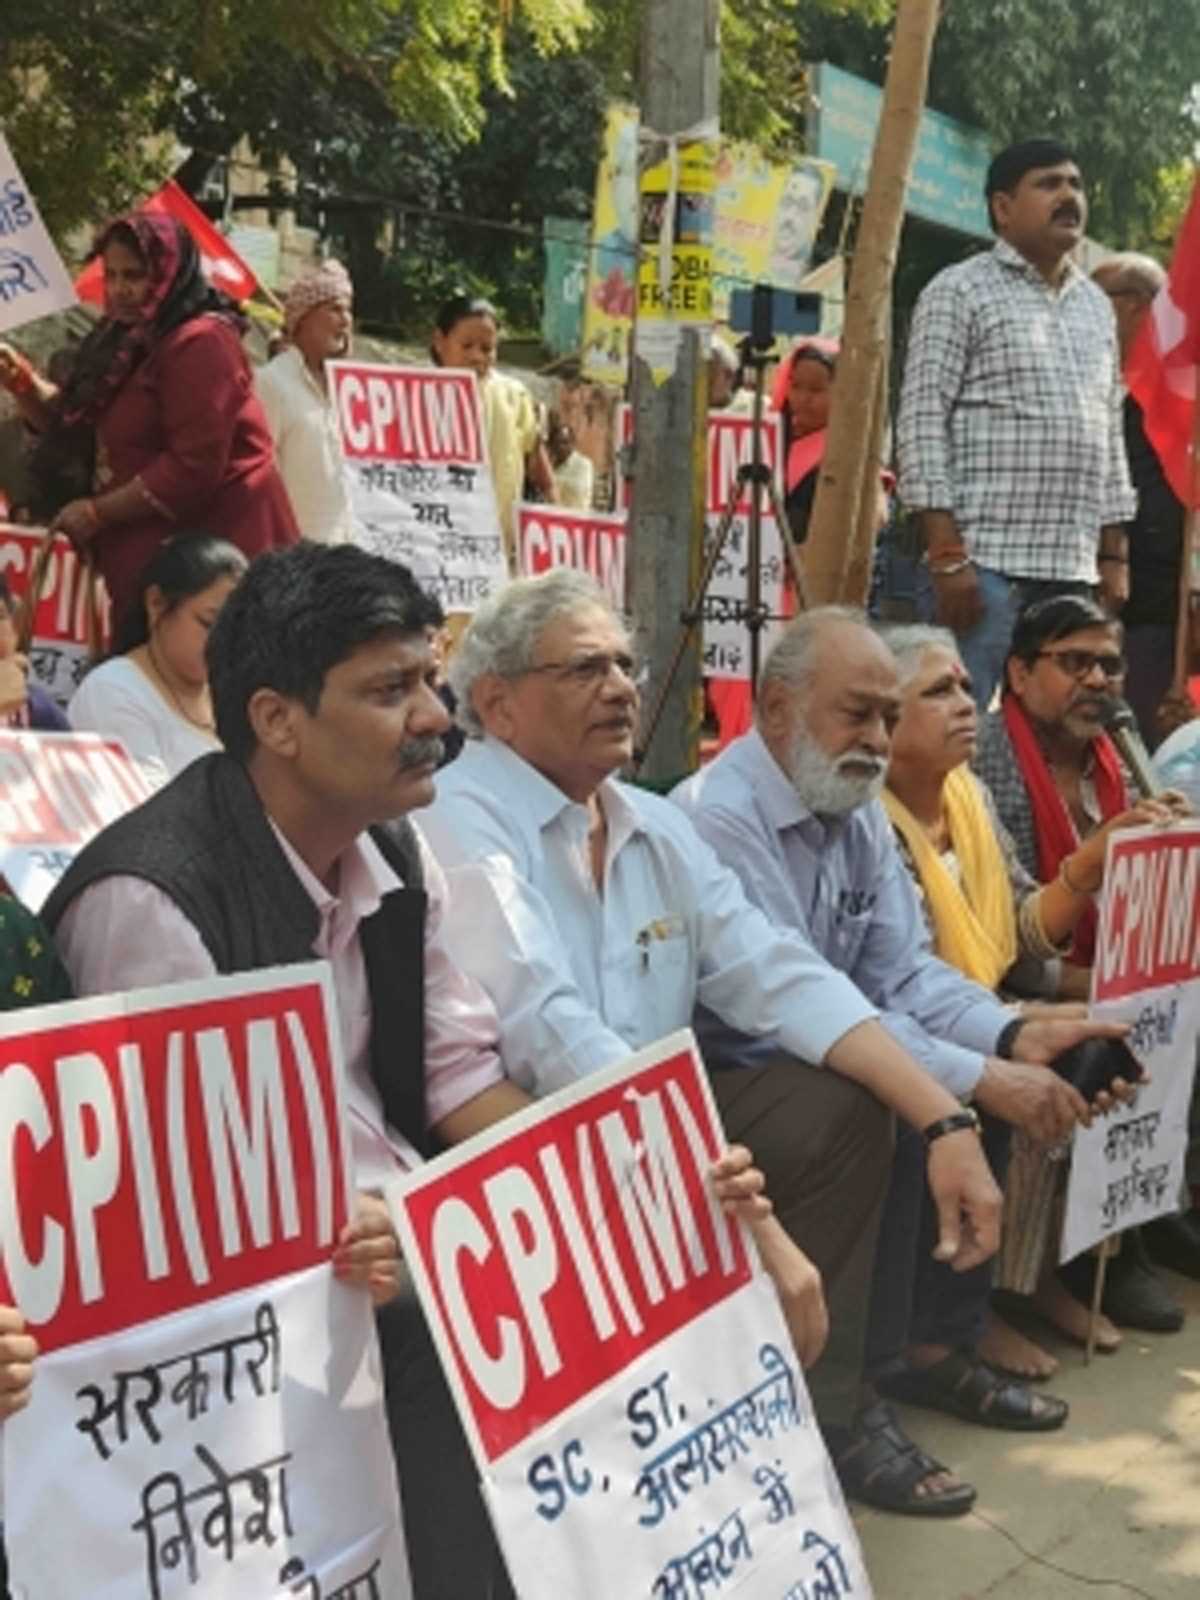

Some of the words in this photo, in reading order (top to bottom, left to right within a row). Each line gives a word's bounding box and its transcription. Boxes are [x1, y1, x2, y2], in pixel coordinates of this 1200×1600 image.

[339, 374, 478, 461] CPI(M)
[0, 1010, 332, 1325] CPI(M)
[431, 1078, 737, 1410] CPI(M)
[76, 1301, 279, 1460] सरकारी
[131, 1443, 293, 1600] निवेश
